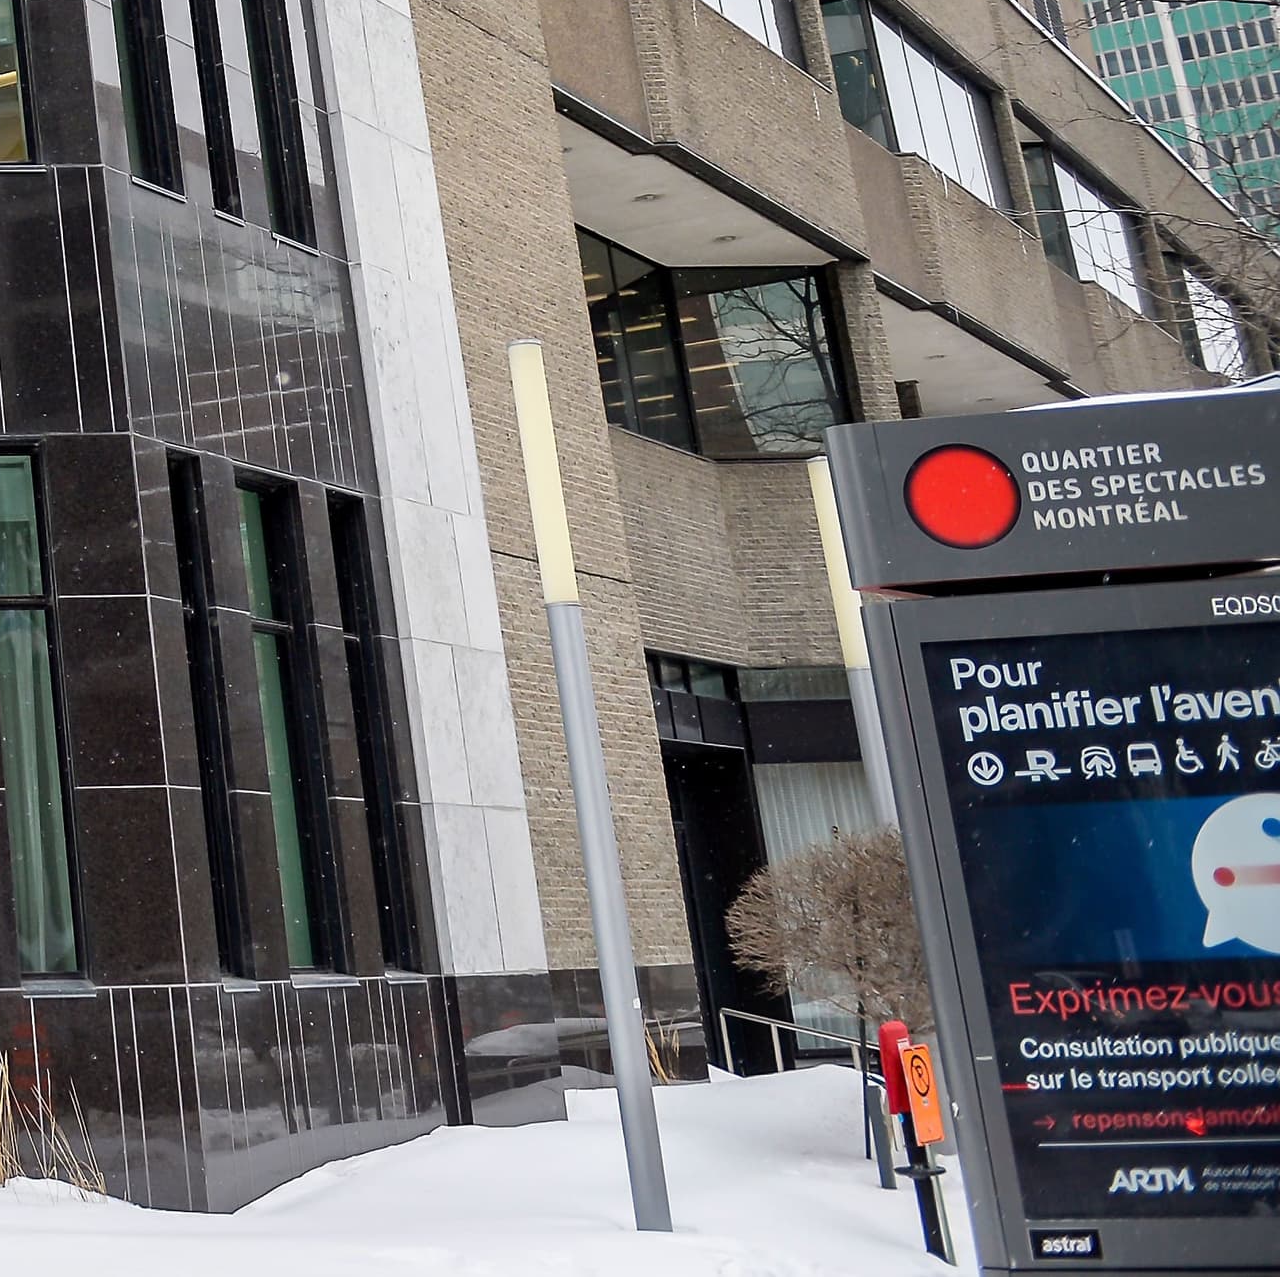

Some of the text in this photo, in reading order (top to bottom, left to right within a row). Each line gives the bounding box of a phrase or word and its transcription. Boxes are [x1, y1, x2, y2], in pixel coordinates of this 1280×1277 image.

[1021, 441, 1163, 474] QUARTIER
[1027, 463, 1267, 502] DES SPECTACLES
[1033, 497, 1189, 531] MONTRÉAL
[949, 657, 1044, 690] Pour
[958, 678, 1280, 742] planifier l'aven
[1020, 1035, 1173, 1058] Consultation
[1026, 1072, 1065, 1091] sur
[1070, 1068, 1093, 1089] le
[1098, 1065, 1213, 1092] transport
[1109, 1166, 1195, 1193] ARTM
[1041, 1235, 1092, 1252] astral
